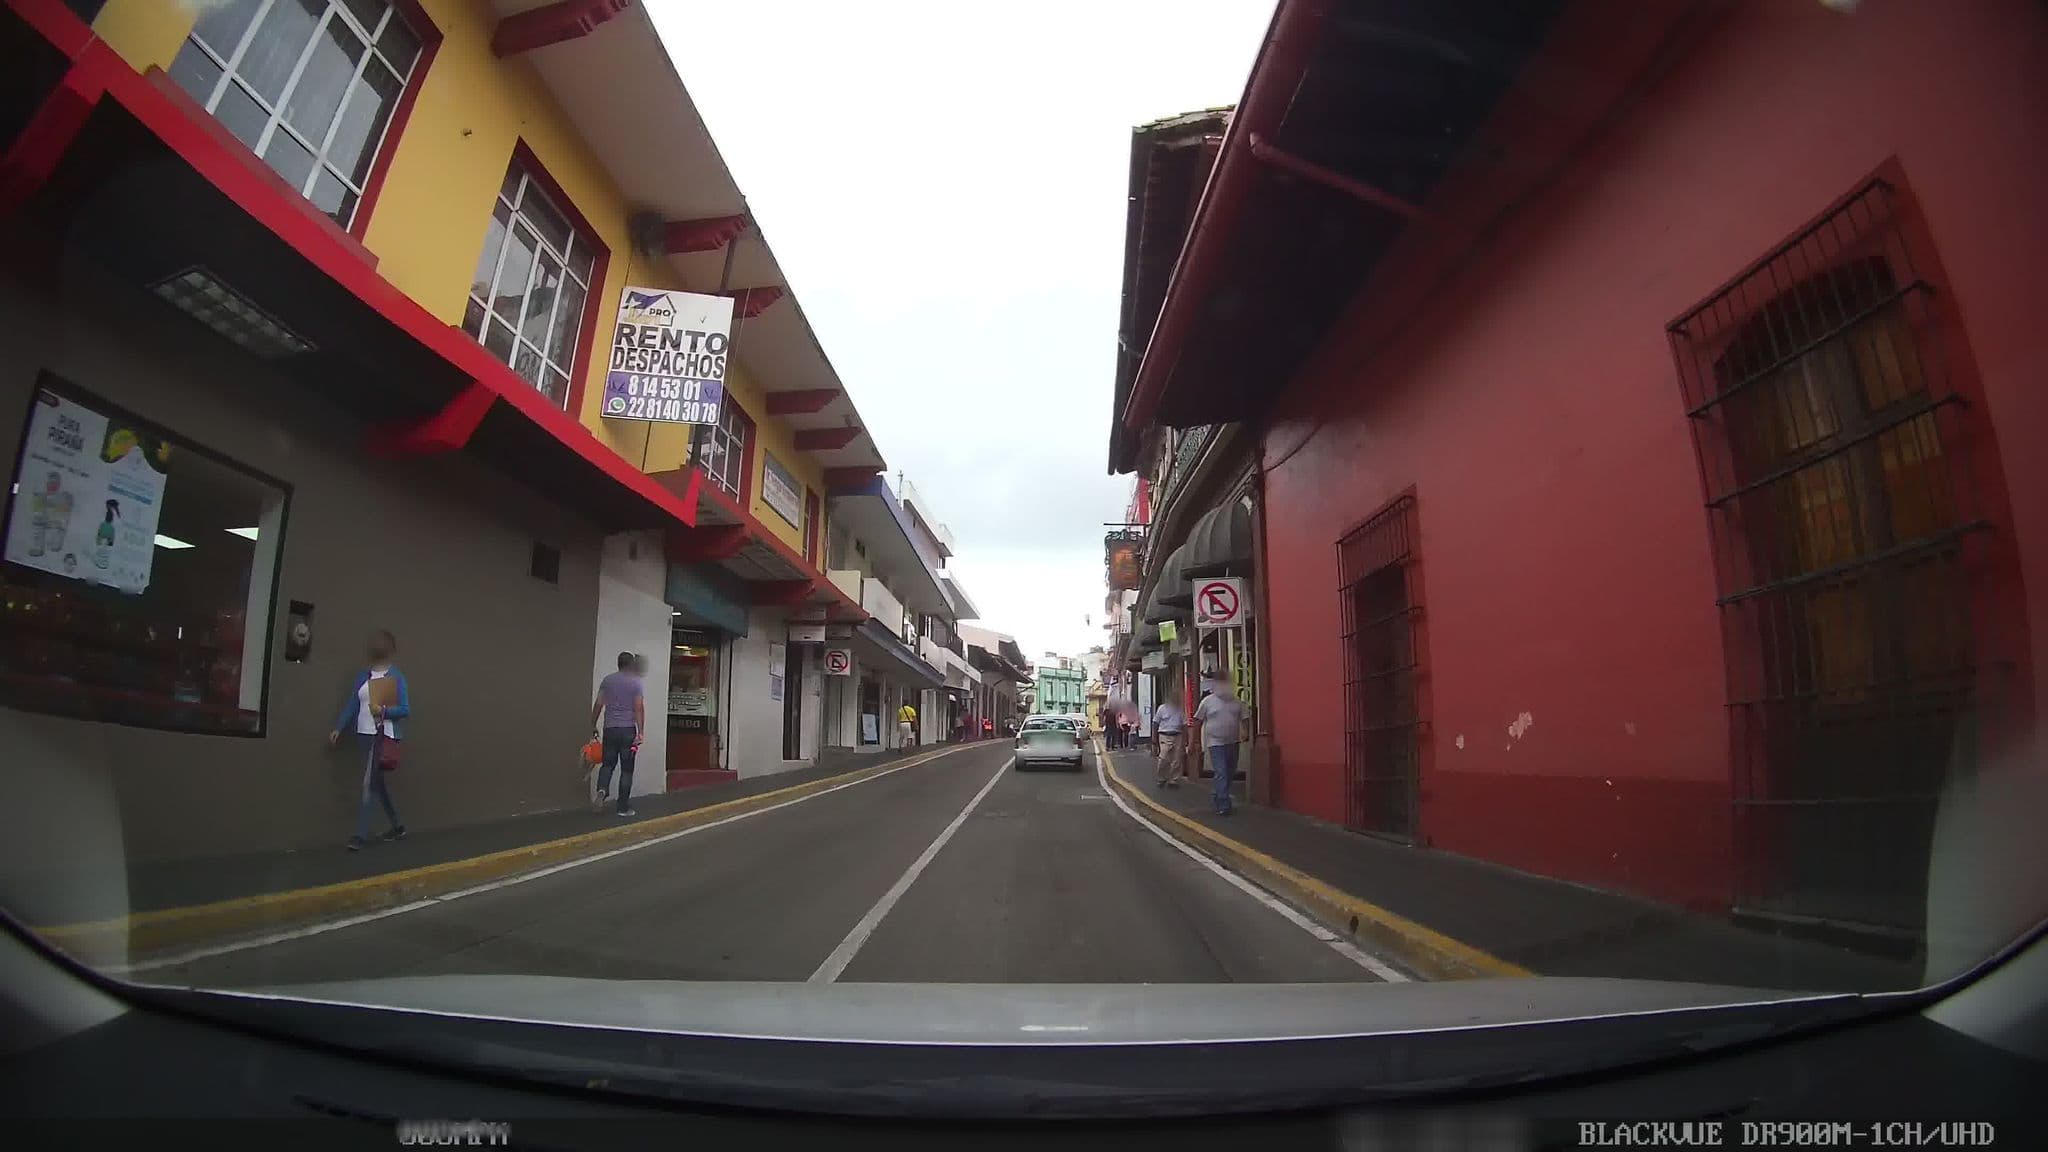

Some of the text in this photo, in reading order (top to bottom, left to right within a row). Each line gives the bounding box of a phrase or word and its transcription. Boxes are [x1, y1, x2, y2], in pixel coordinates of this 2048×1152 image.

[649, 308, 671, 316] PRO
[615, 323, 728, 355] RENTO
[613, 347, 725, 378] DESPACHOS
[628, 375, 701, 401] 8 14 53 01
[627, 396, 645, 418] 22
[682, 401, 700, 422] 30
[702, 402, 717, 423] 78
